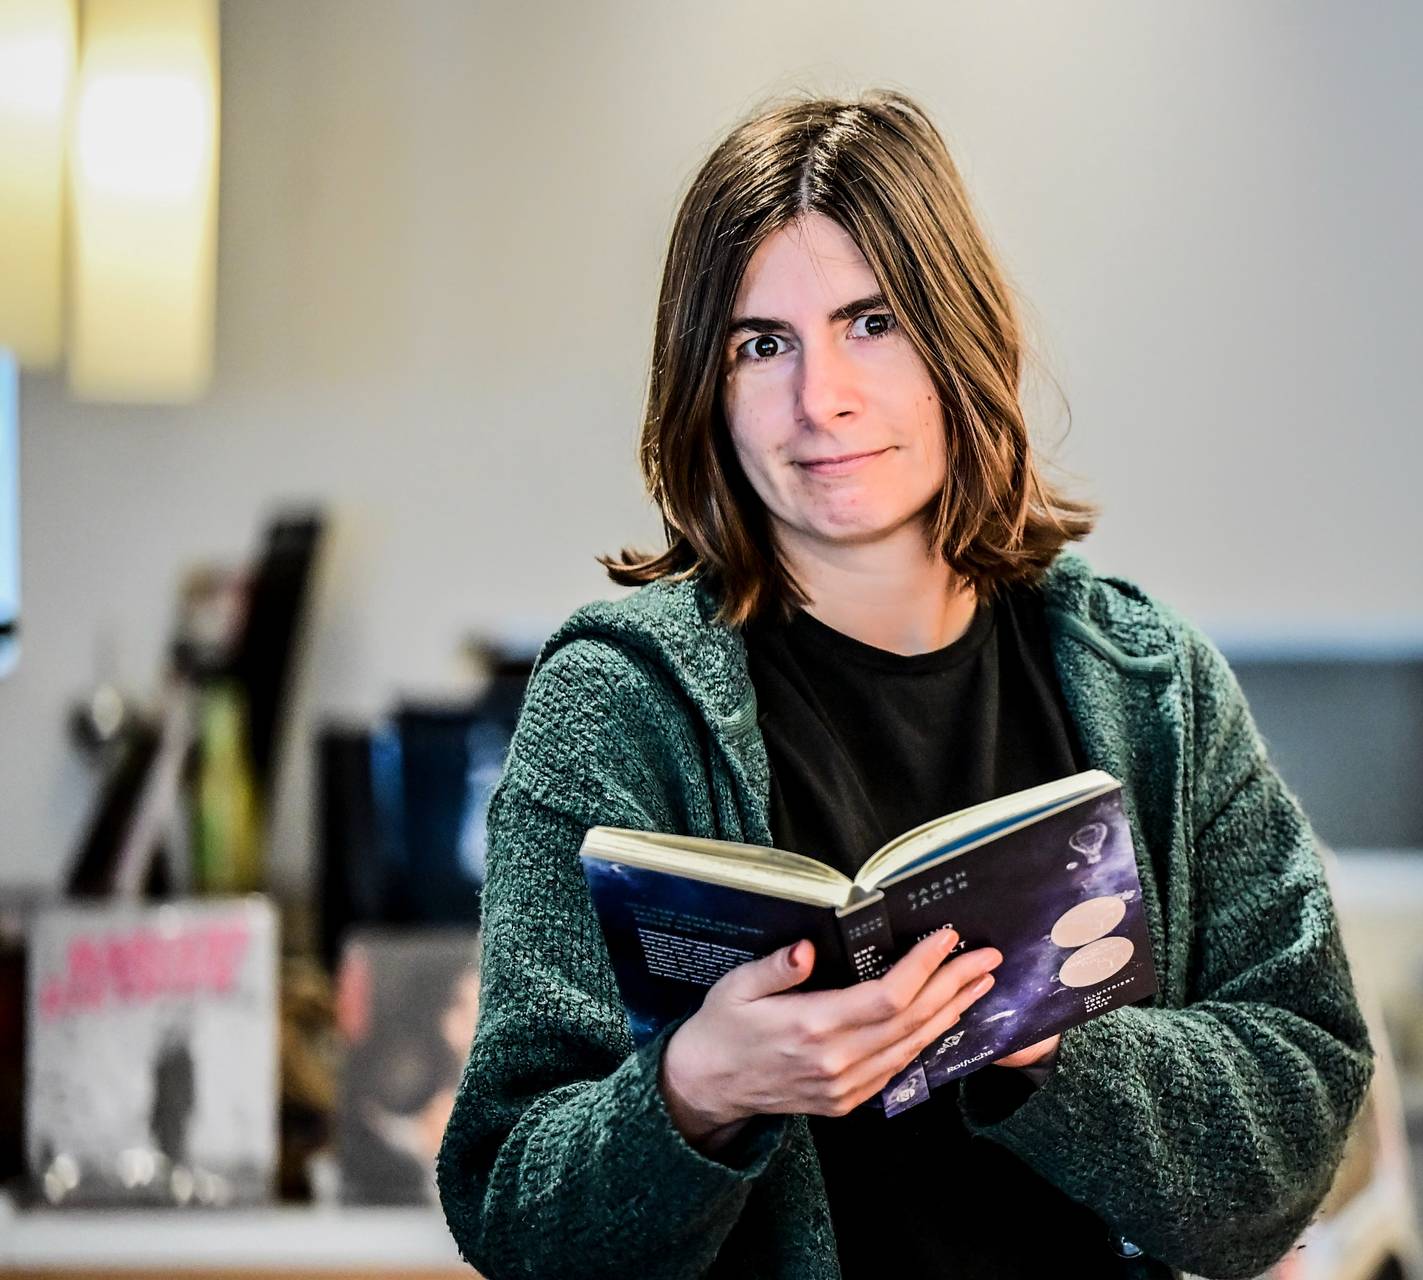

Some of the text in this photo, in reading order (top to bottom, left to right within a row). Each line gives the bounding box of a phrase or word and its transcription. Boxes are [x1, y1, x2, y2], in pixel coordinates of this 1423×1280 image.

[908, 870, 967, 901] SARAH
[1083, 976, 1135, 1002] ILLUSTRIERT
[1085, 995, 1112, 1009] SARAH
[1086, 1001, 1109, 1013] MAUS
